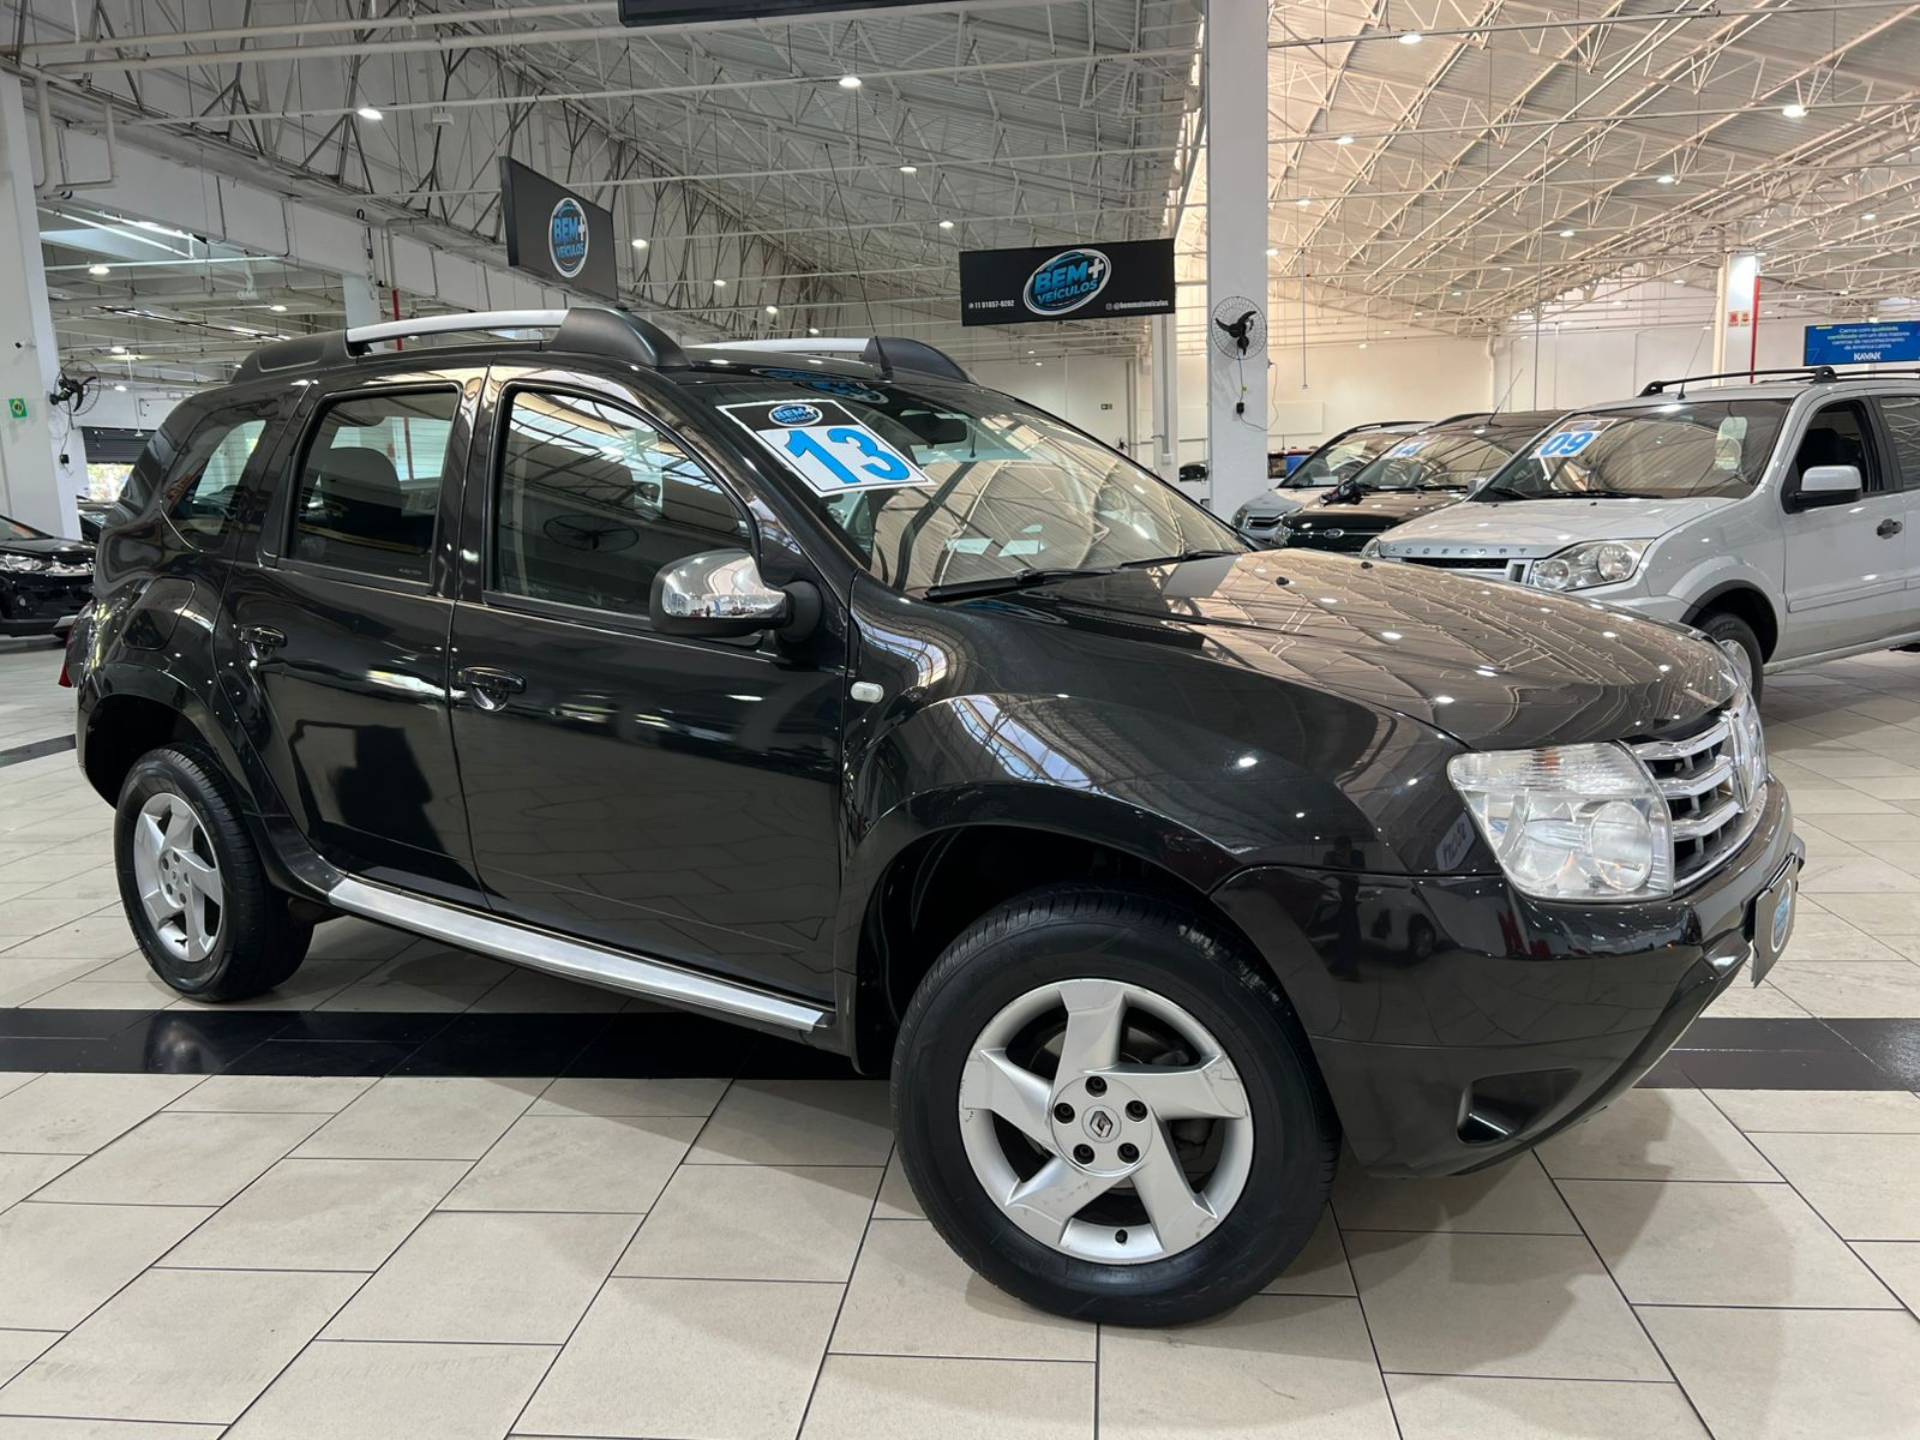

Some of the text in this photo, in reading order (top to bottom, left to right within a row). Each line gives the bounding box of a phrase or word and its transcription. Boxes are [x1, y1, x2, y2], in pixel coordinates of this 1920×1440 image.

[1036, 280, 1098, 305] VEÍCULOS
[784, 428, 911, 484] 13
[1540, 432, 1593, 456] 09
